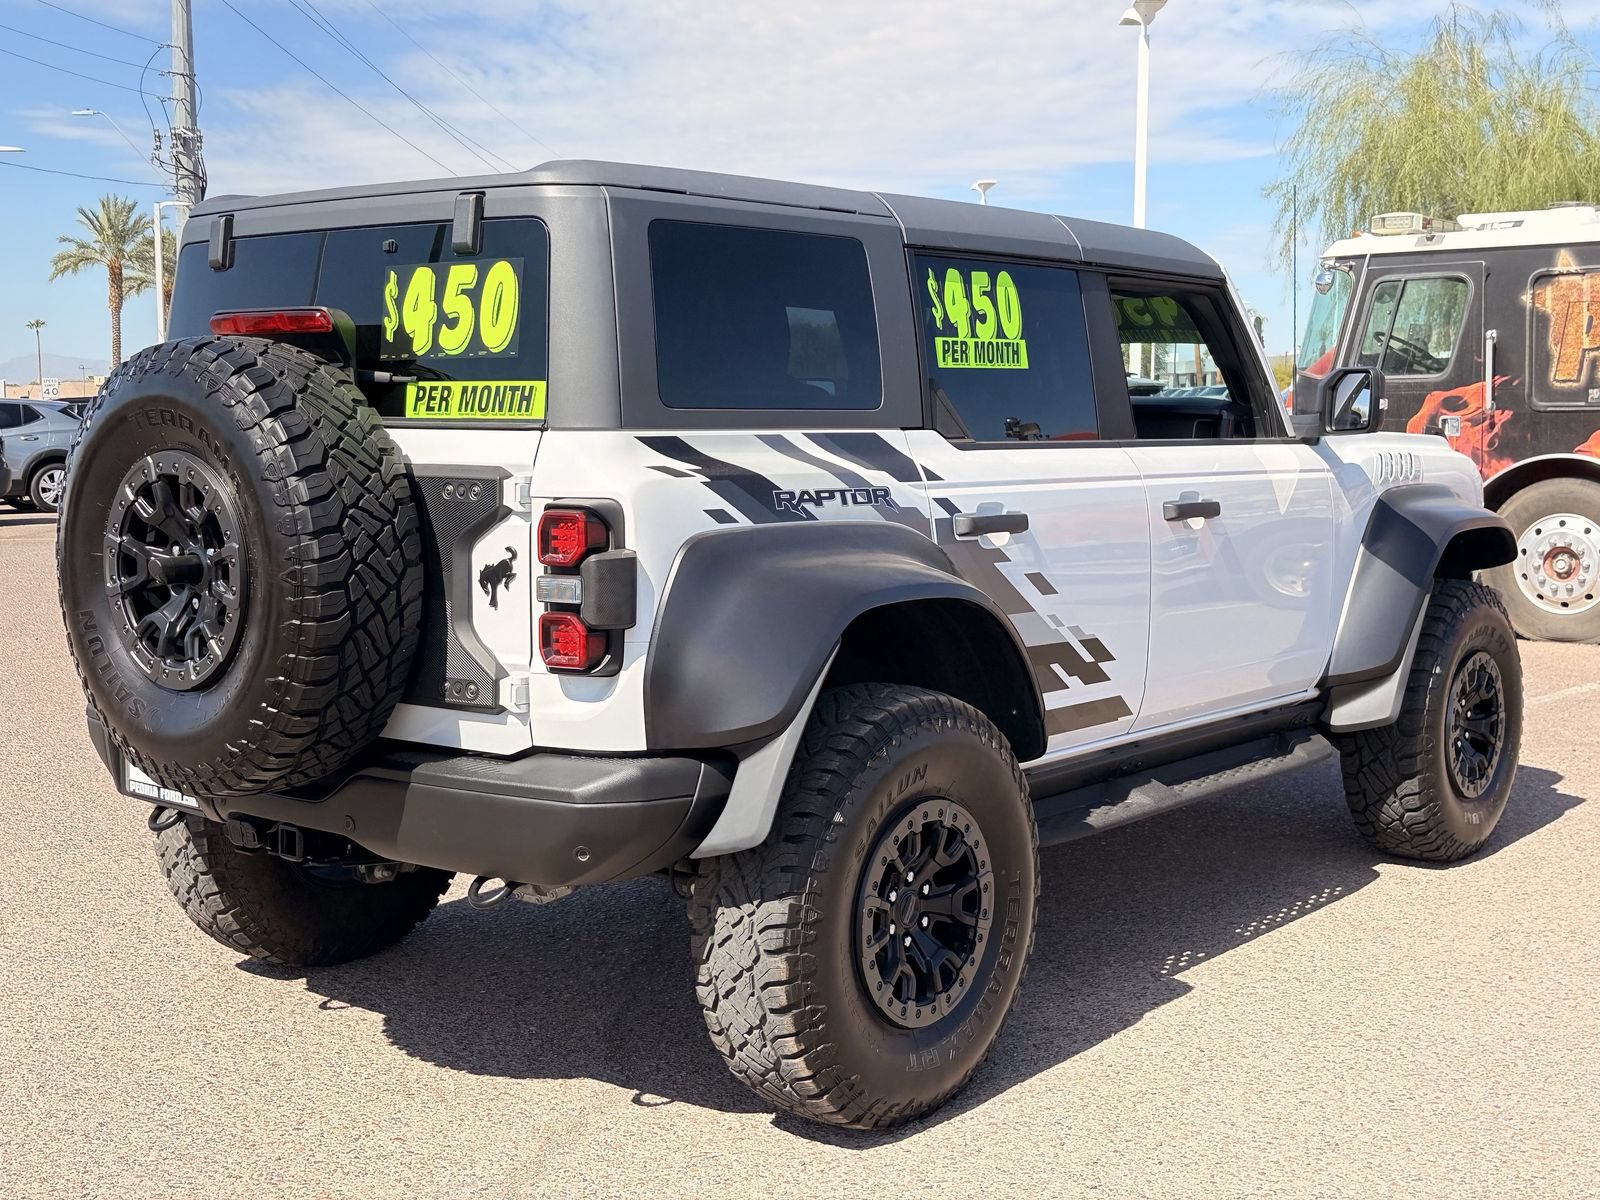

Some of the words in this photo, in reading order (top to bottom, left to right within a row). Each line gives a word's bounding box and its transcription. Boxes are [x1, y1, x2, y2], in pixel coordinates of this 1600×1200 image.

[384, 261, 518, 356] $450
[927, 268, 1022, 340] $450
[942, 340, 970, 365] PER
[974, 341, 1021, 366] MONTH
[413, 385, 454, 416] PER
[458, 385, 537, 417] MONTH
[773, 486, 899, 518] RAPTOR
[79, 608, 147, 720] SAILUN
[854, 762, 928, 861] SAILUN
